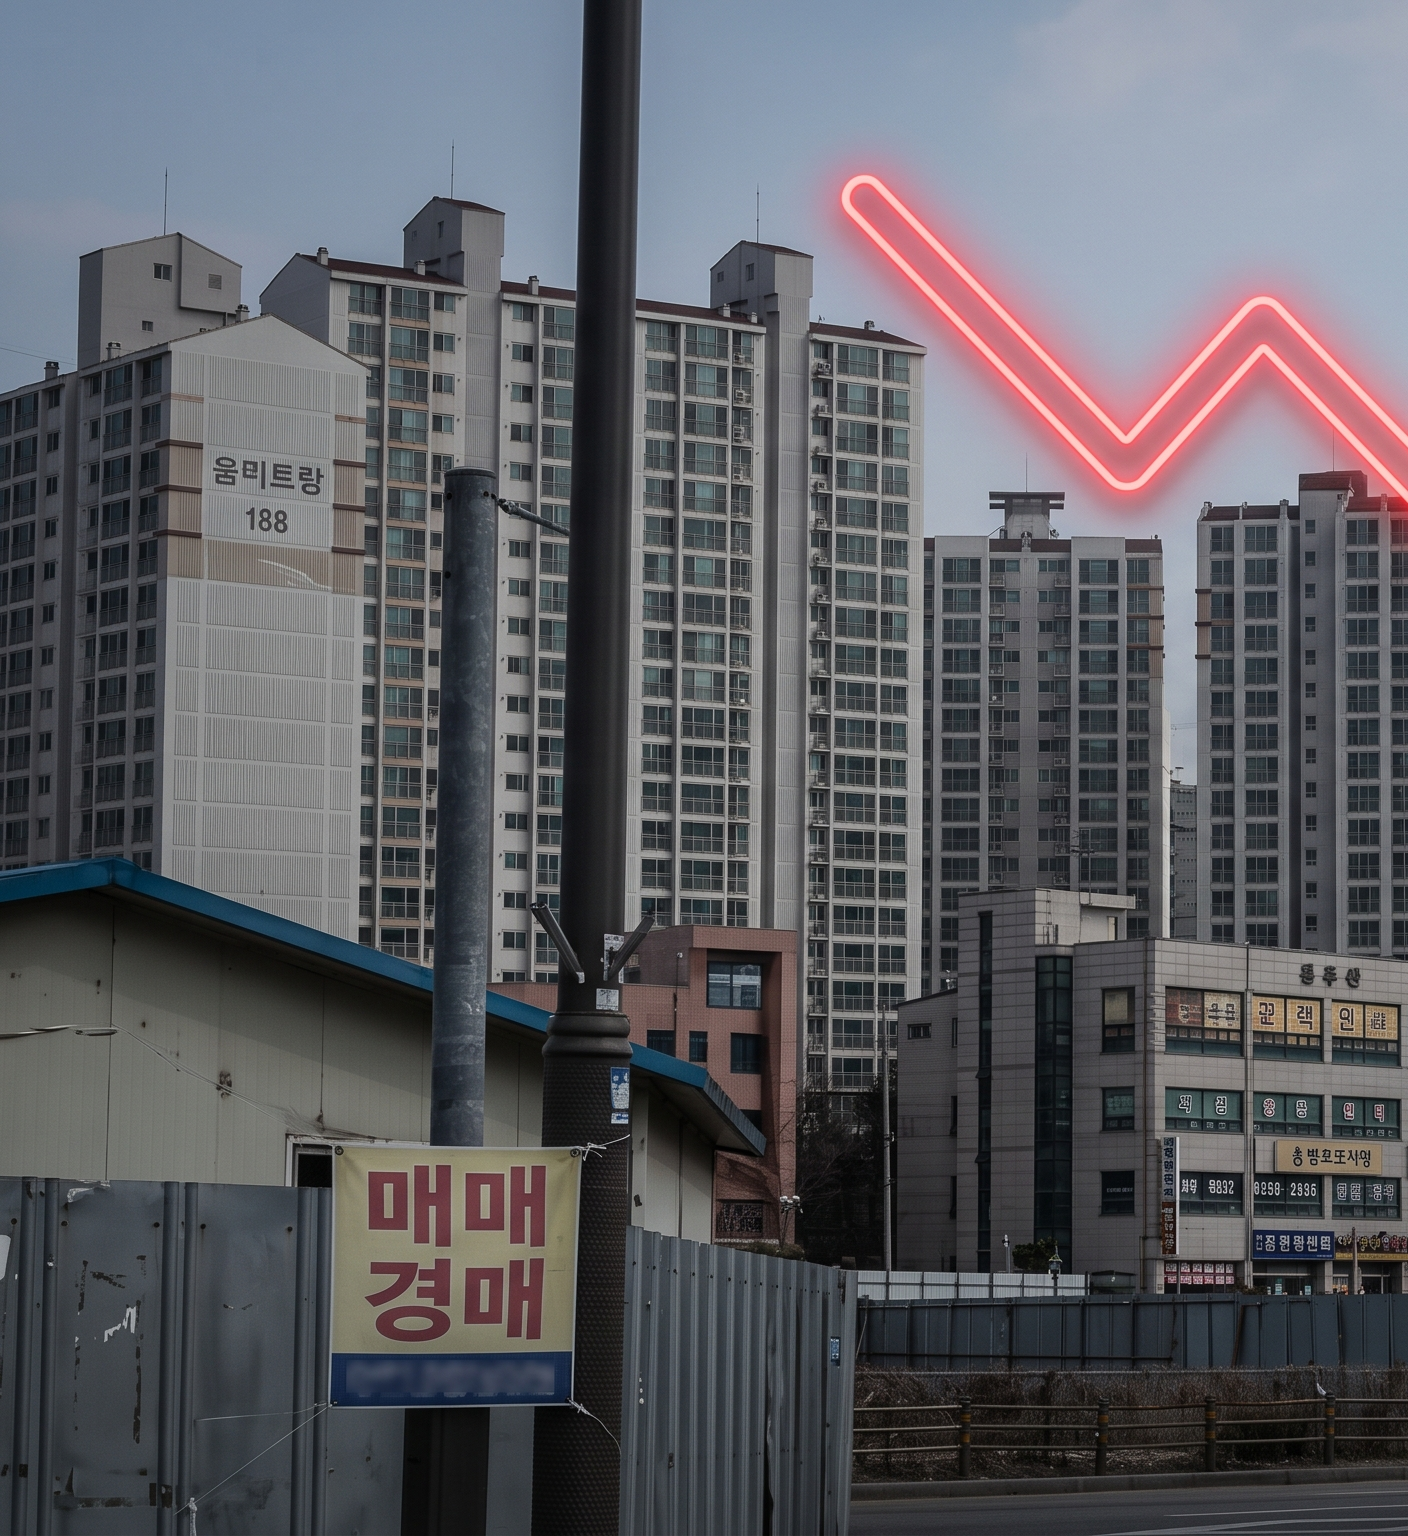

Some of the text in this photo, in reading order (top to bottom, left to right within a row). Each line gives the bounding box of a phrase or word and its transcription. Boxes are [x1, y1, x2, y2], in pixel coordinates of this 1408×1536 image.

[245, 506, 288, 534] 188
[367, 1164, 547, 1248] 매매
[364, 1257, 546, 1342] 경매
